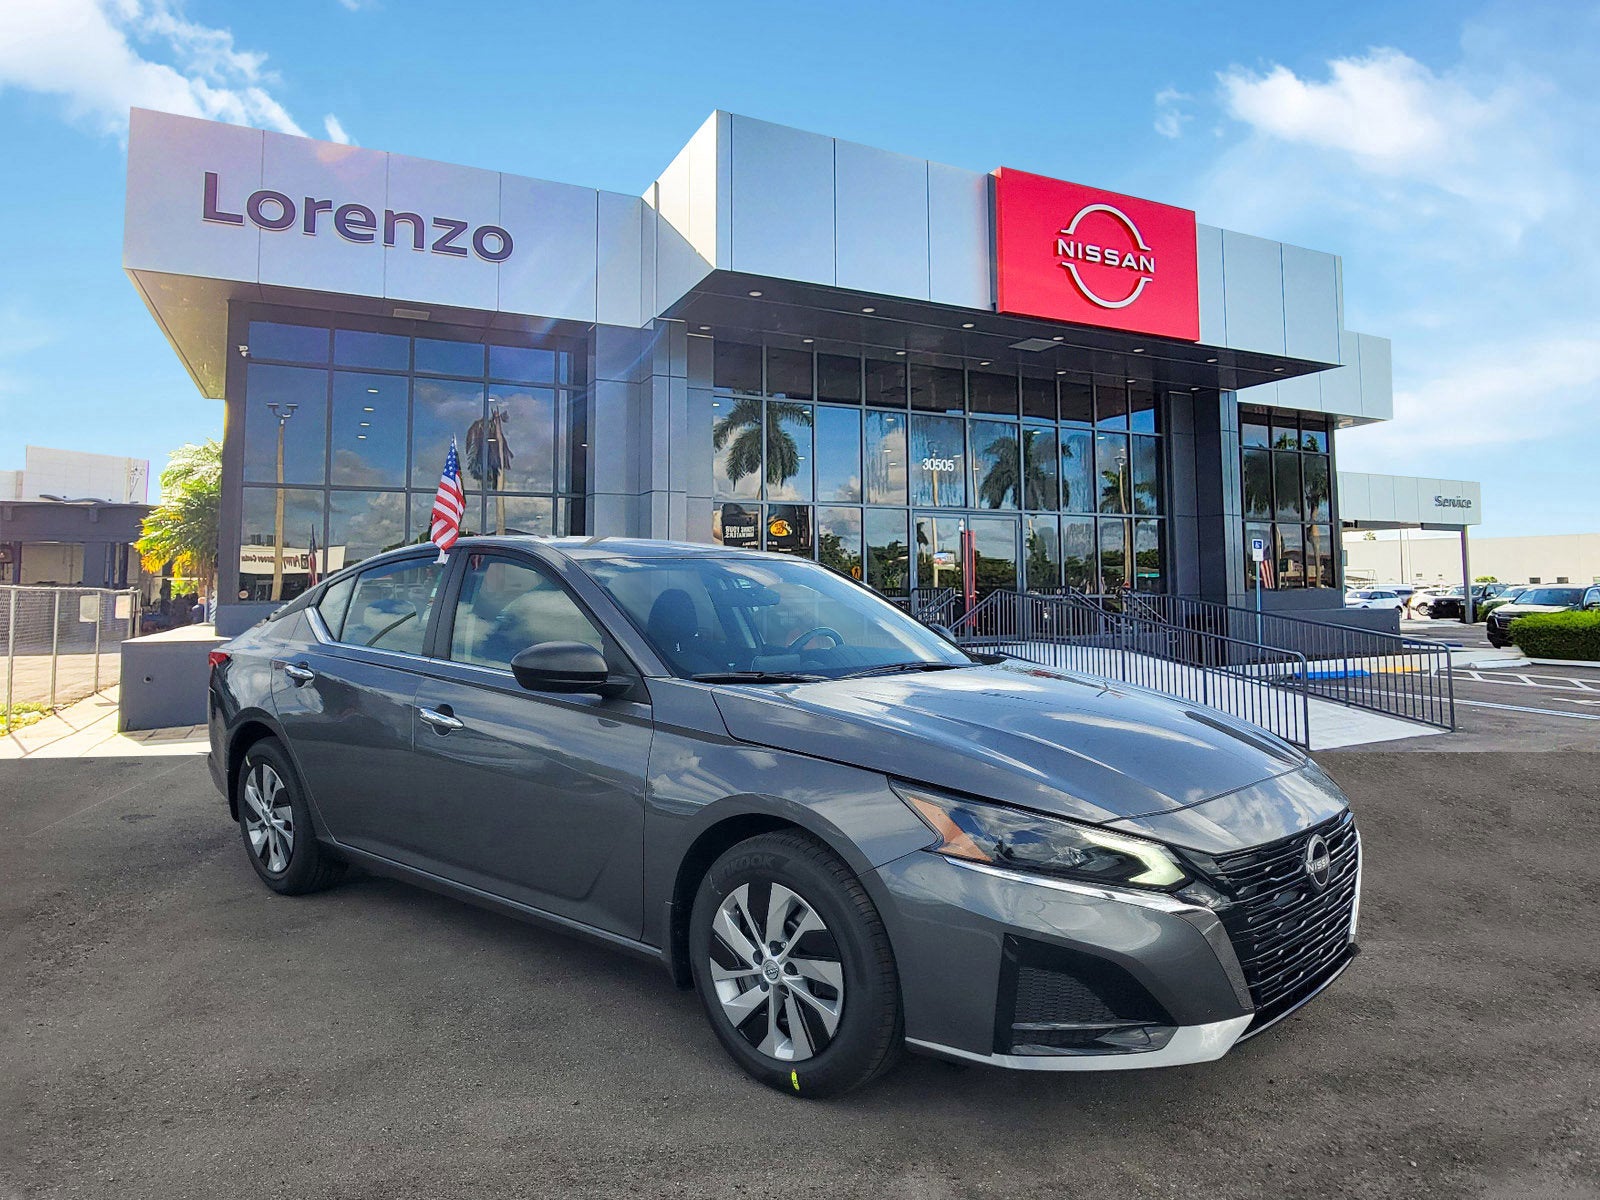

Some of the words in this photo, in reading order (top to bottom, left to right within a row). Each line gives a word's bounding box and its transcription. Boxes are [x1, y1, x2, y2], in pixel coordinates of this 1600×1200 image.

[203, 171, 514, 263] Lorenzo
[1057, 238, 1155, 273] NISSAN
[922, 458, 955, 472] 30505
[1434, 495, 1472, 509] Service
